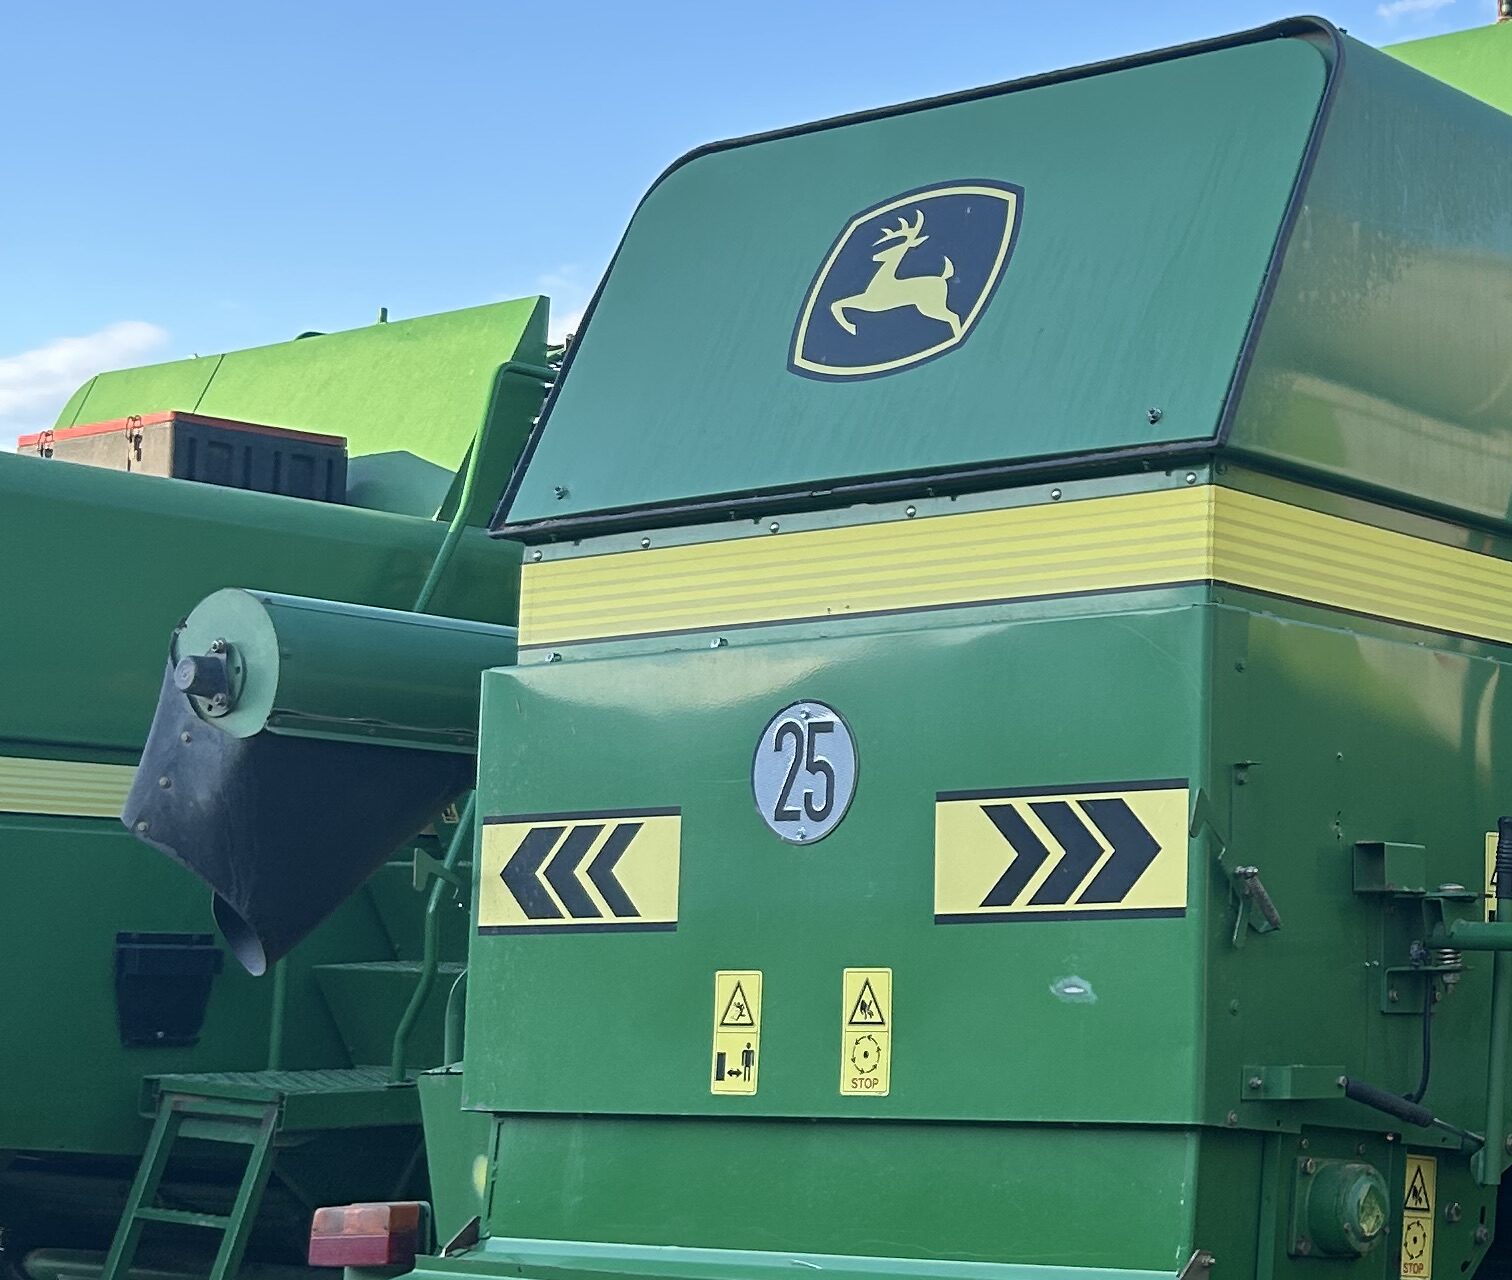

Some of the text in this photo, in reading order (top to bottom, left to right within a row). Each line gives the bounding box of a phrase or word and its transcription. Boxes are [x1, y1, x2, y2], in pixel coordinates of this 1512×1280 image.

[774, 721, 834, 822] 25
[851, 1077, 879, 1089] STOP
[1403, 1262, 1424, 1274] STOP
